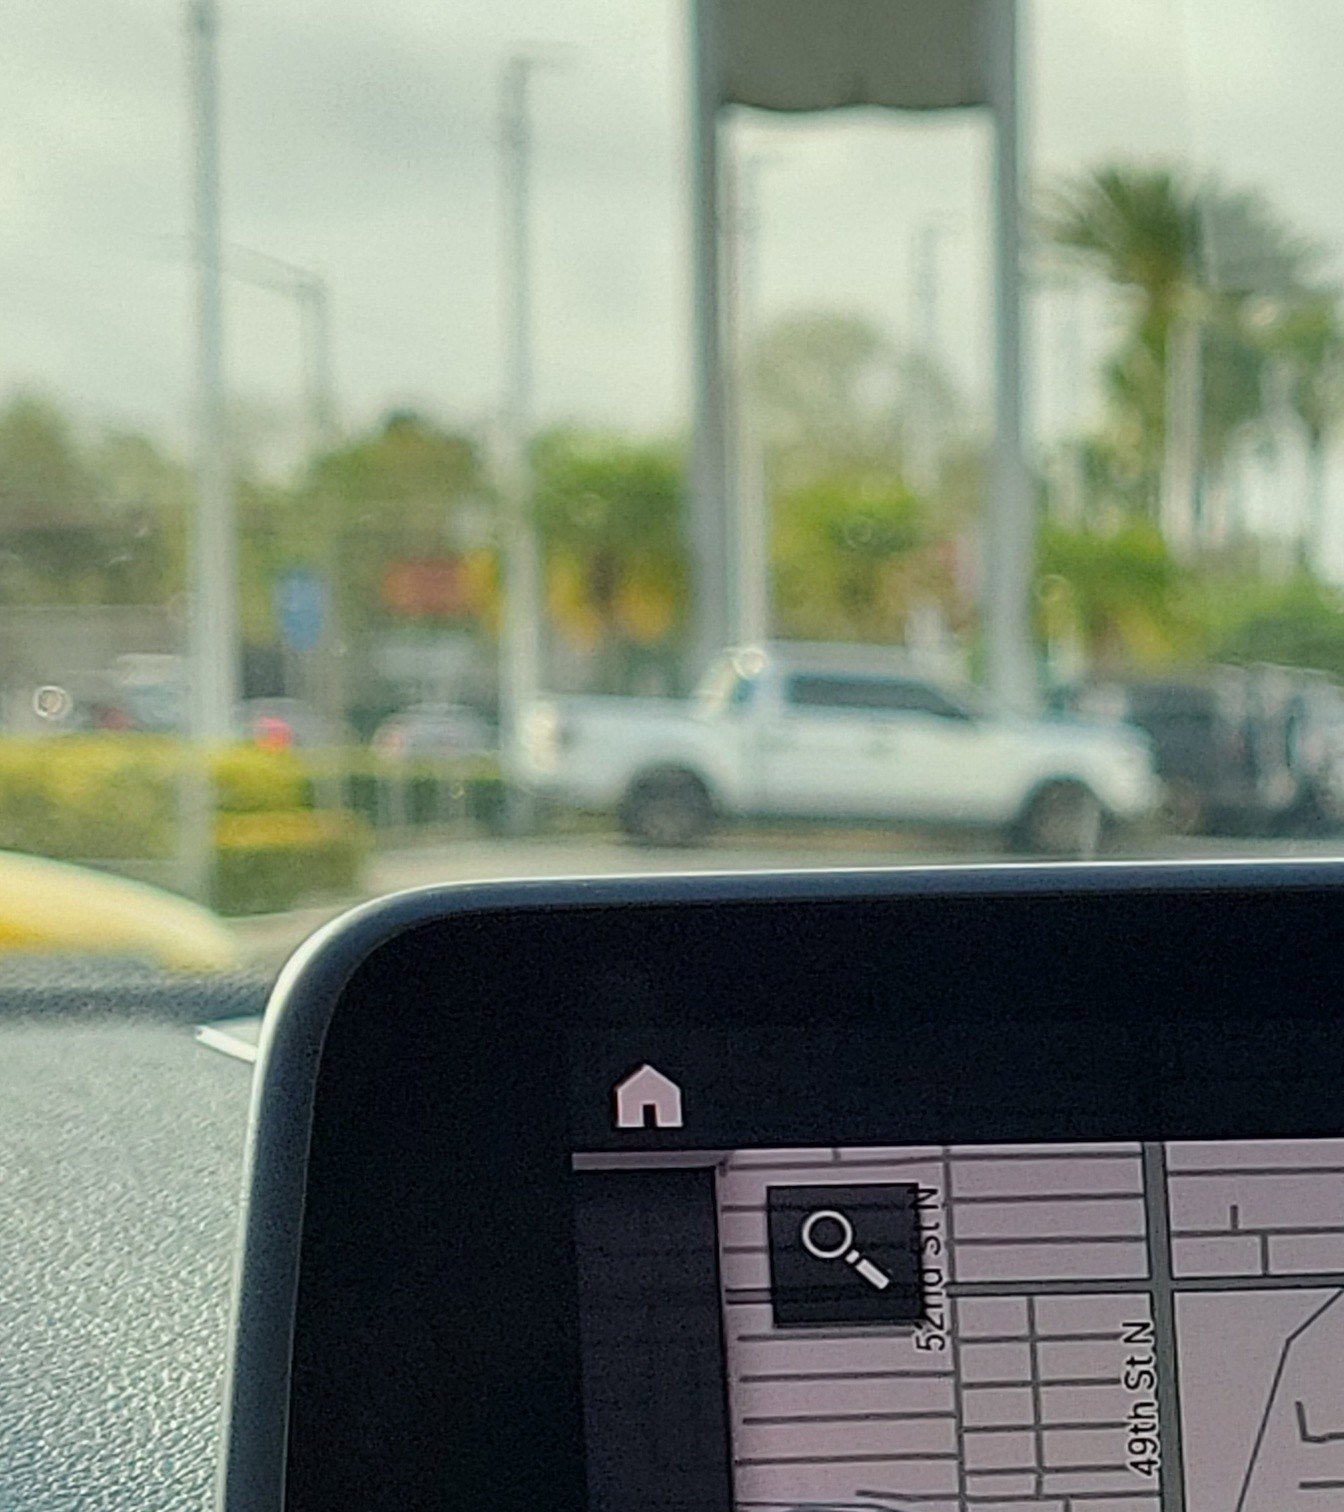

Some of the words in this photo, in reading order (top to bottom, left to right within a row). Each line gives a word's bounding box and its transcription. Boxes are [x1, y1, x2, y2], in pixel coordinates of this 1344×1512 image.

[1124, 1321, 1151, 1345] N
[1124, 1350, 1152, 1390] St
[1129, 1401, 1158, 1477] 49th
